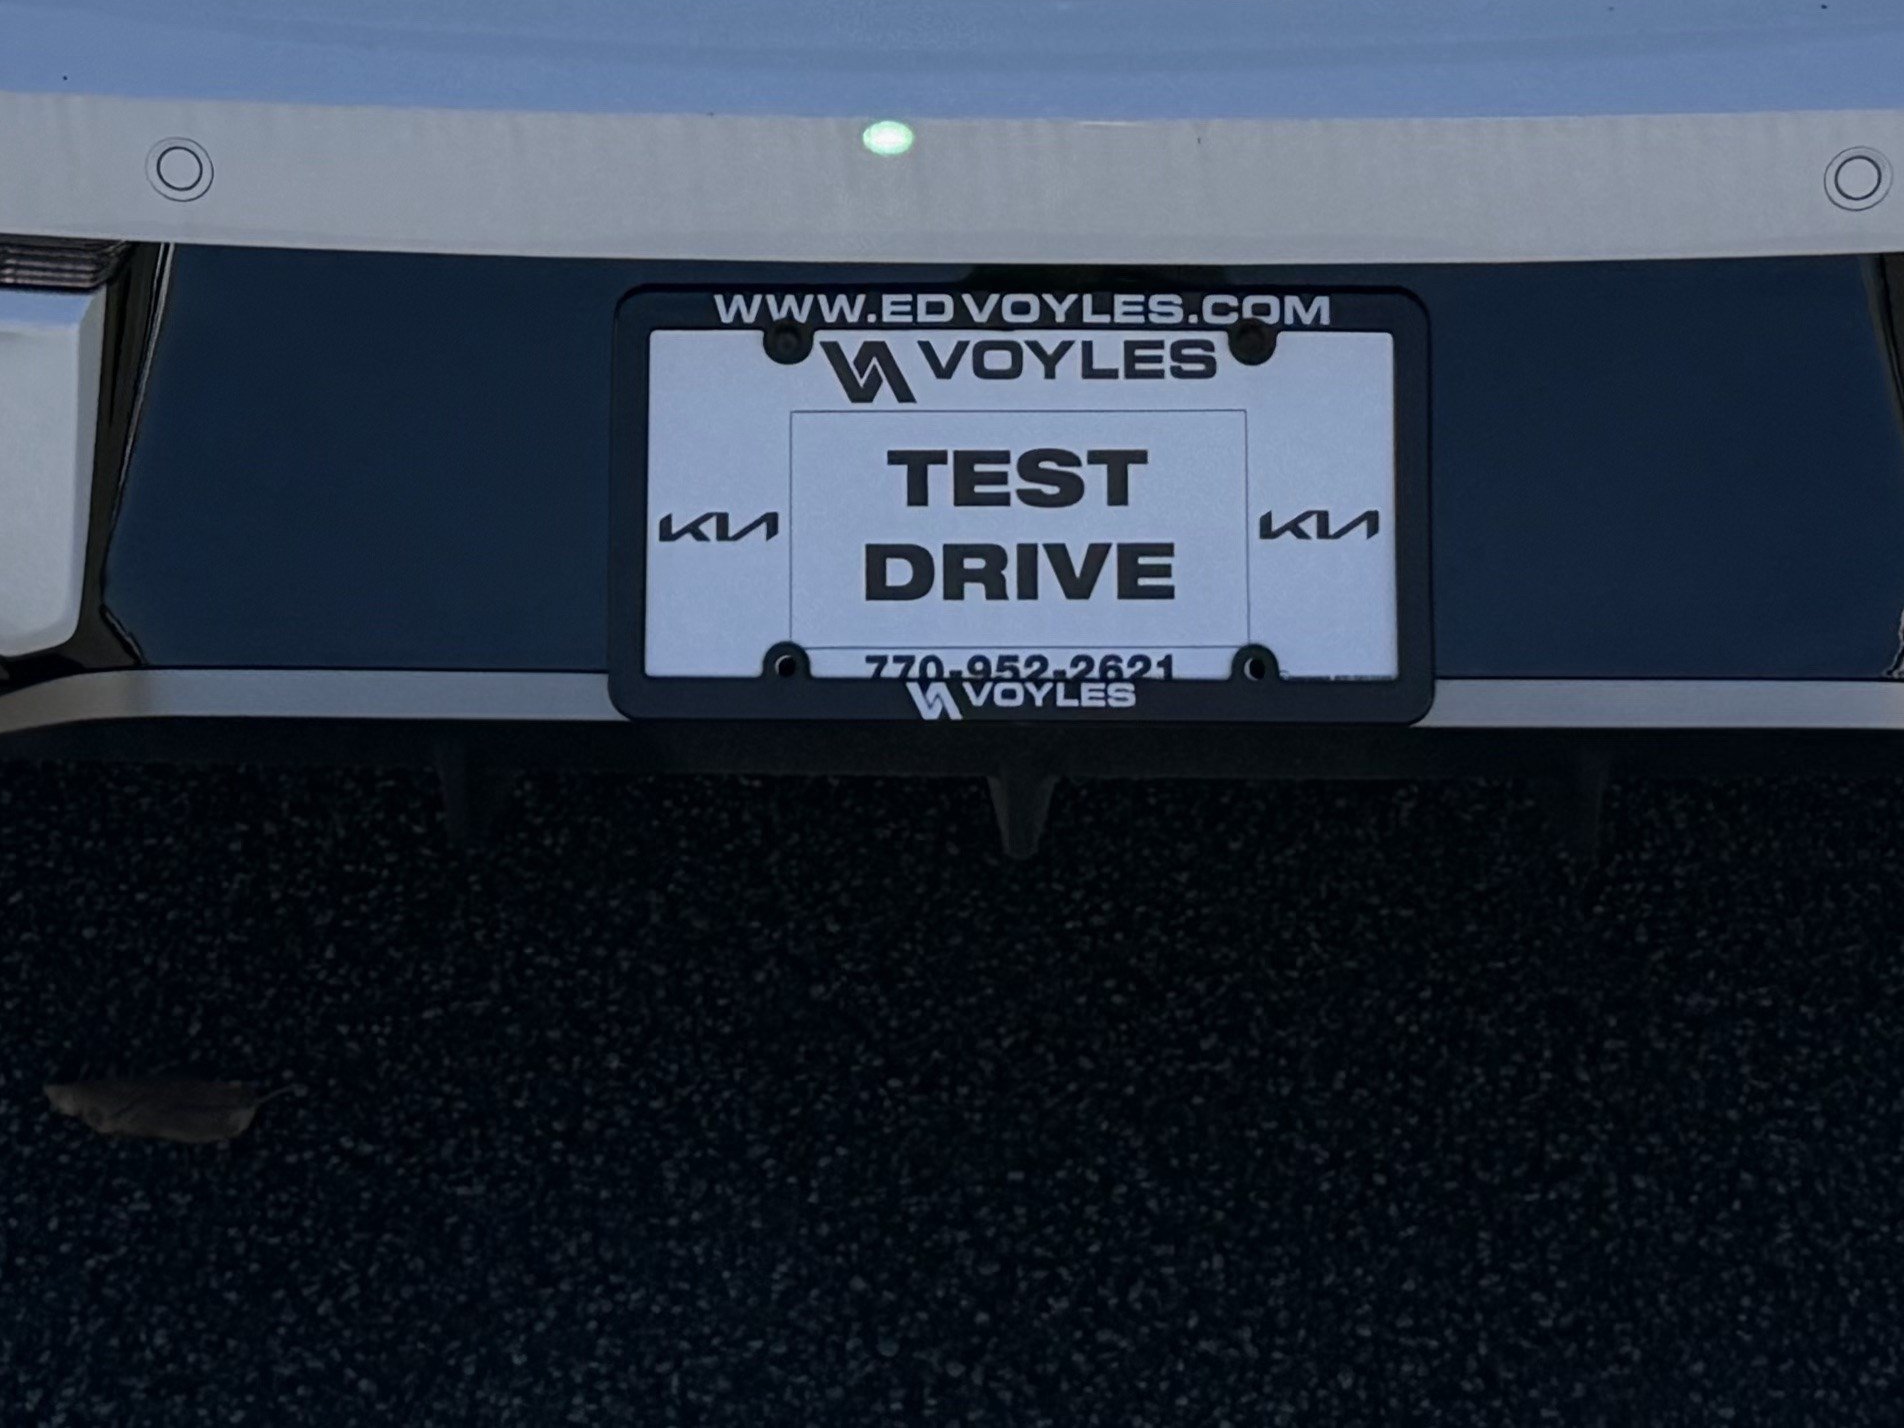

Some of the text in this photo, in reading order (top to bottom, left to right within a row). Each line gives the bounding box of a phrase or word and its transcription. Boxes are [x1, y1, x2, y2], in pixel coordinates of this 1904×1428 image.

[919, 339, 1217, 380] VOYLES
[887, 448, 1148, 508] TEST
[658, 511, 778, 542] KIA
[1259, 509, 1380, 540] KIA
[864, 543, 1175, 601] DRIVE
[865, 654, 1173, 679] 770-952-2621
[963, 682, 1136, 707] VOYLES
